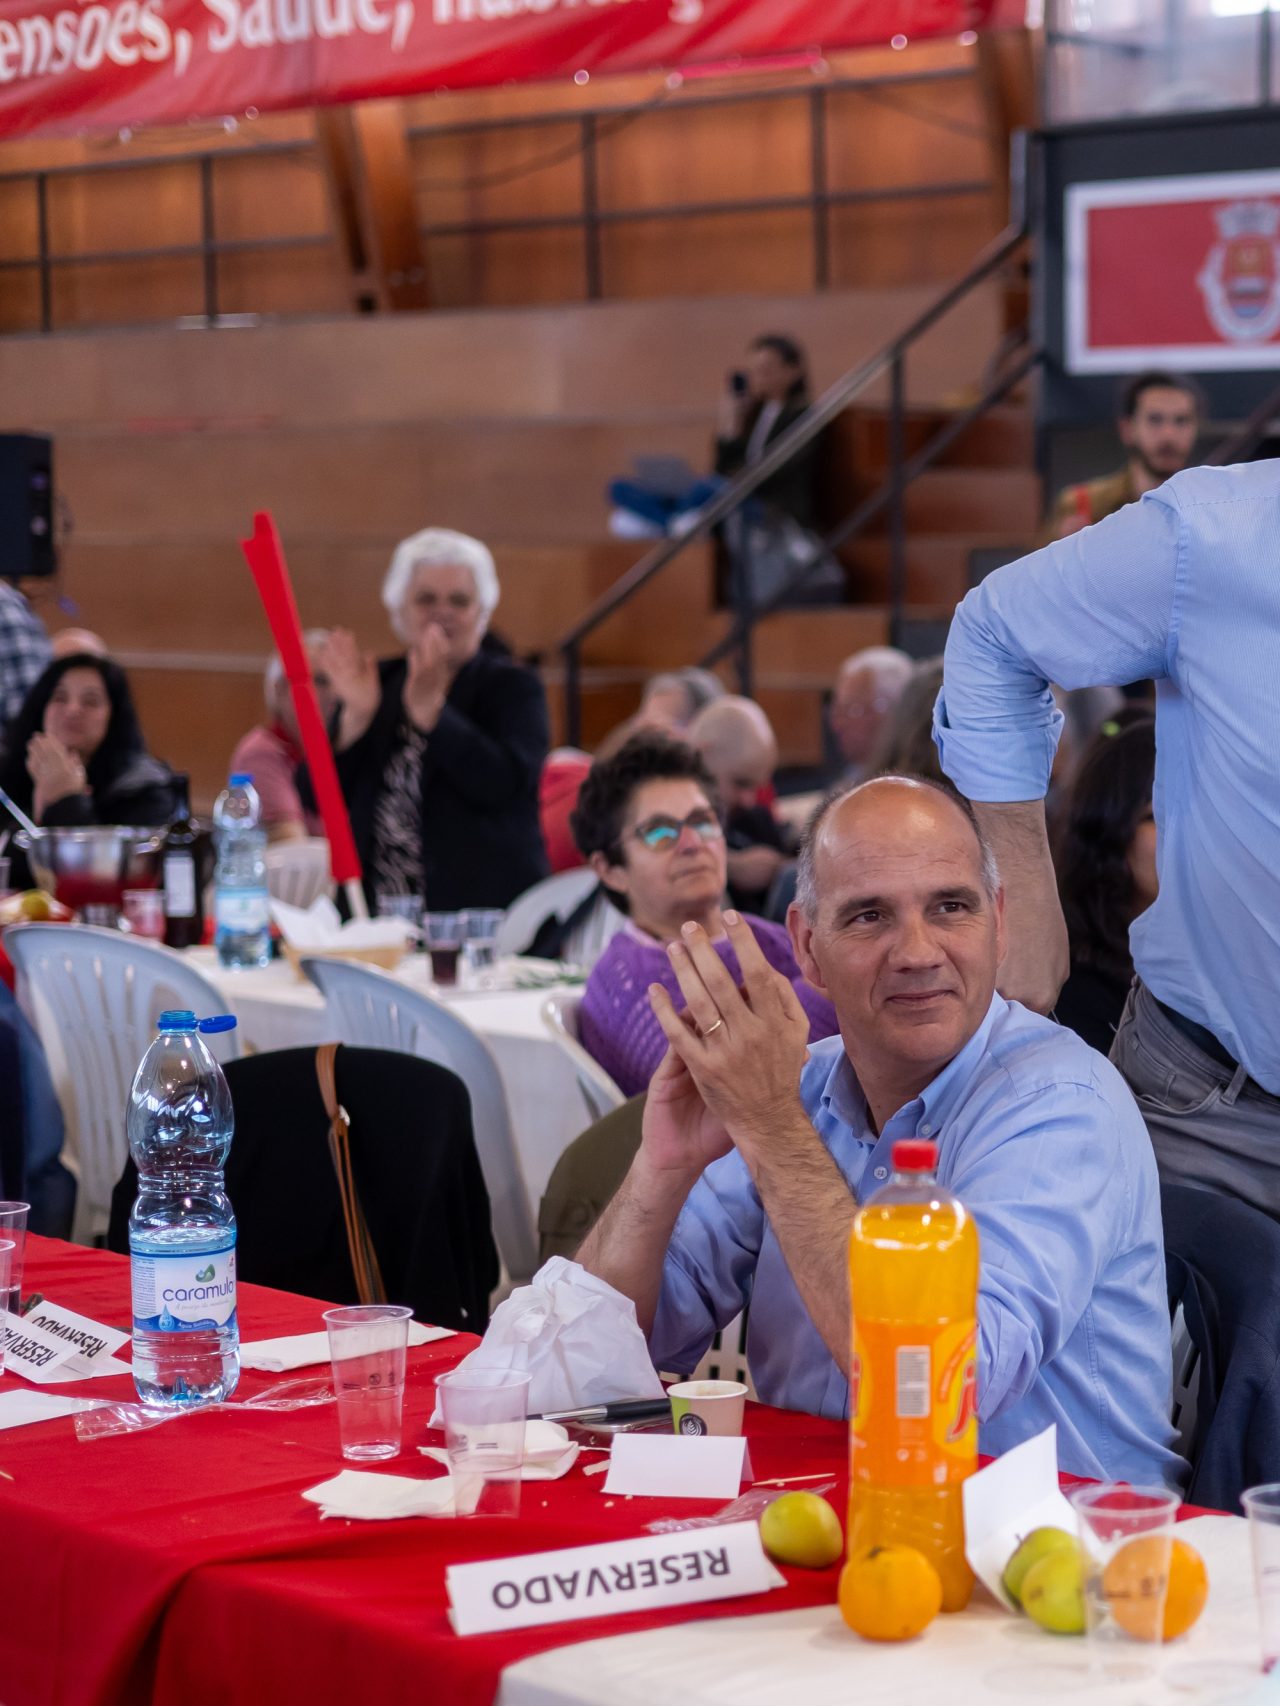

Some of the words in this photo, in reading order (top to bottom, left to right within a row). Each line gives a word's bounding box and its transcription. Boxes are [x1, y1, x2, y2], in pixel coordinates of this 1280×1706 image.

[162, 1276, 234, 1302] caramulo
[3, 1327, 58, 1367] RESERVA
[491, 1546, 731, 1611] RESERVADO
